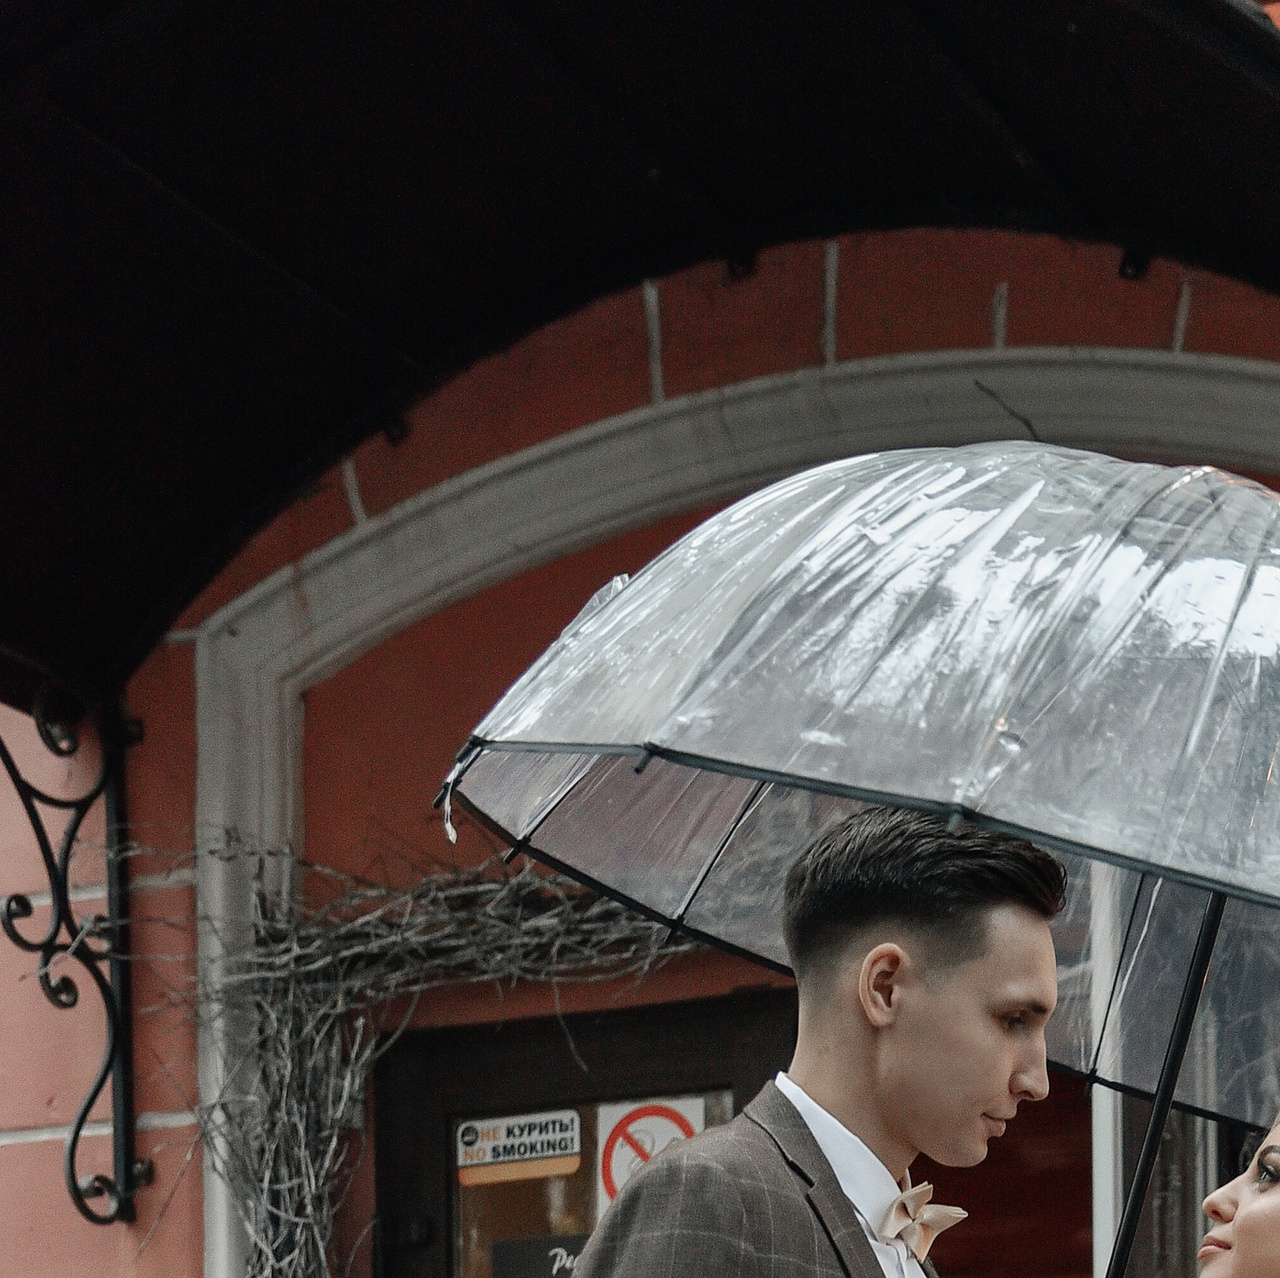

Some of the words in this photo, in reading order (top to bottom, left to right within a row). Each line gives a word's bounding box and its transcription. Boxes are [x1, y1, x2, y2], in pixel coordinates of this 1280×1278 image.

[506, 1117, 574, 1139] КУРИТЬ!
[464, 1147, 486, 1160] NO
[492, 1138, 574, 1159] SMOKING!
